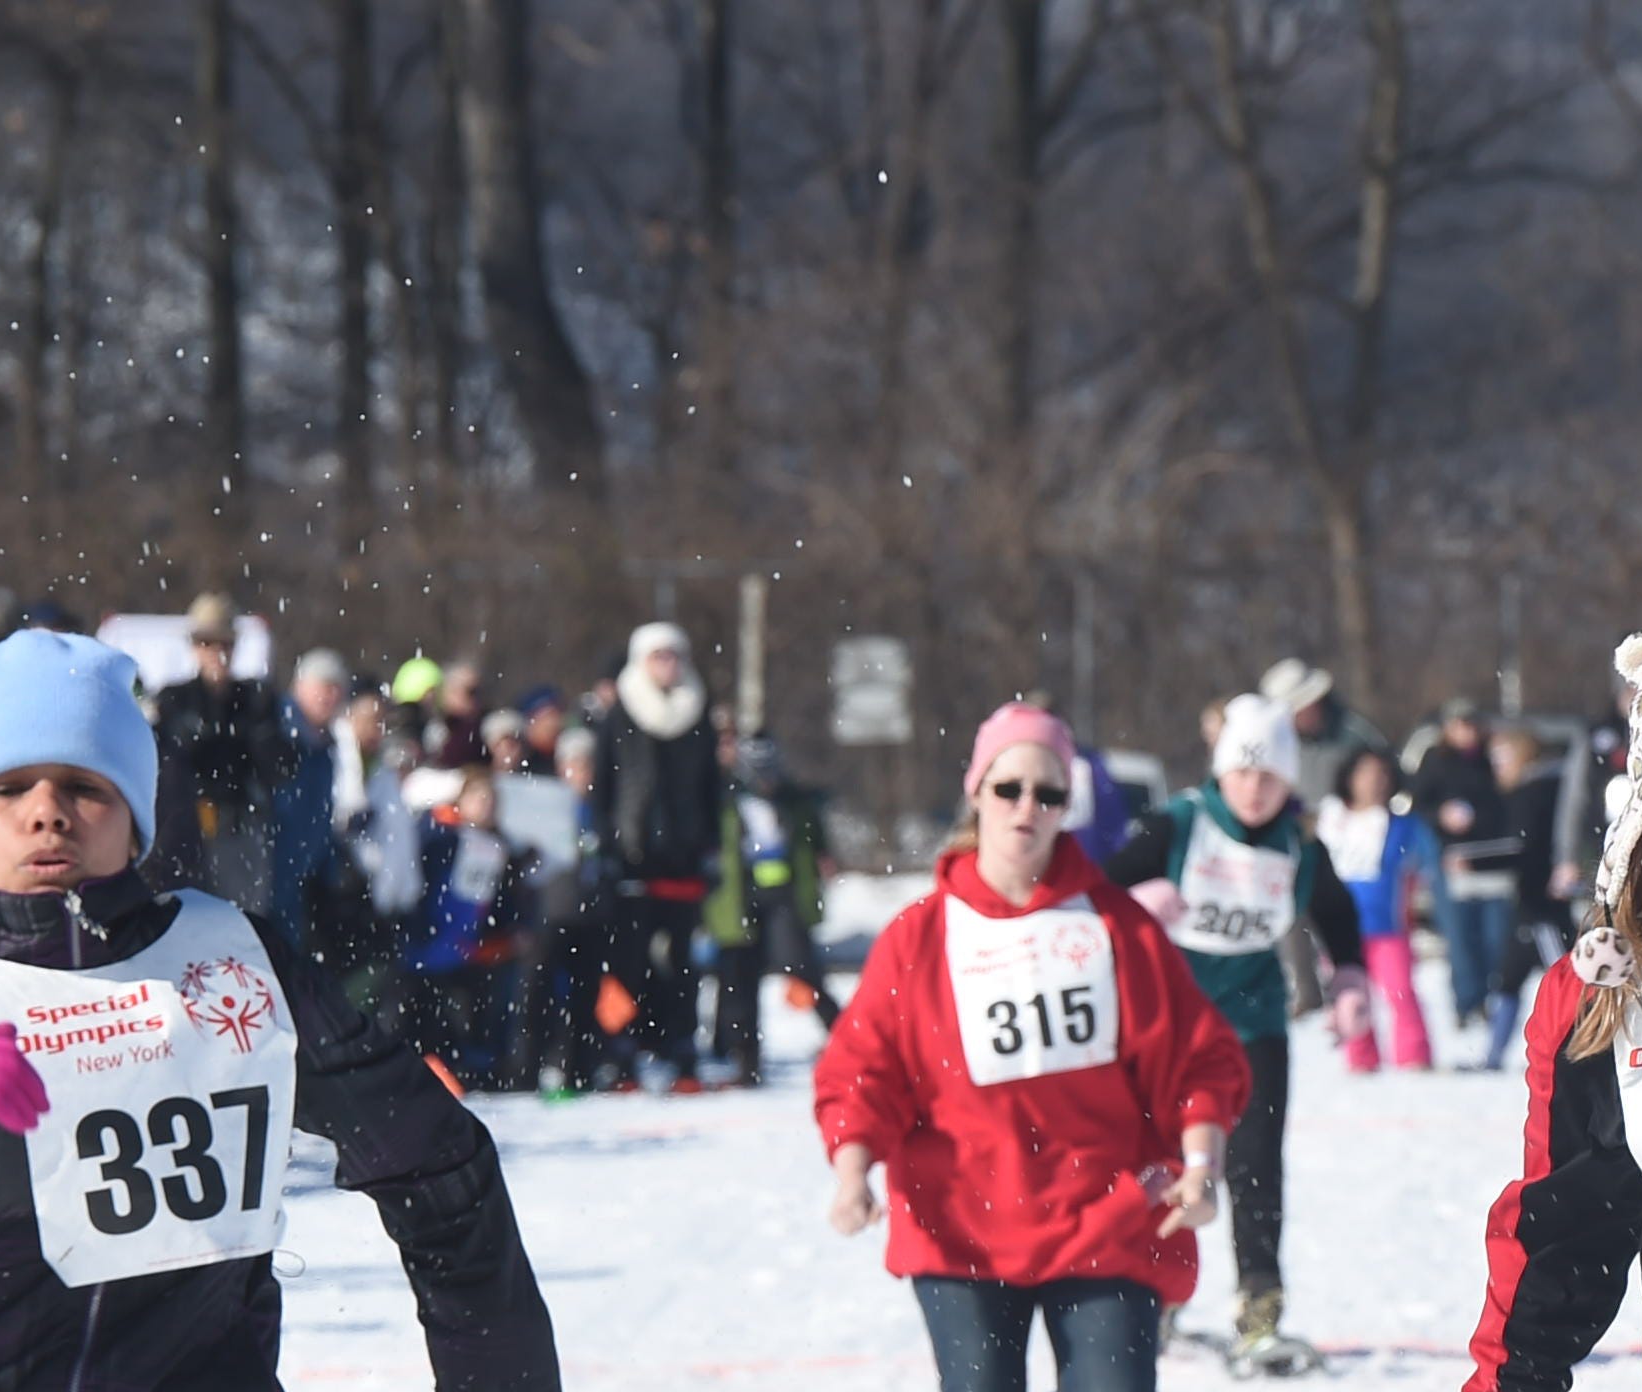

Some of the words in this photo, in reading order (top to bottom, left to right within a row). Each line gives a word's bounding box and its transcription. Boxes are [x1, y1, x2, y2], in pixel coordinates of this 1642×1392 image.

[26, 983, 150, 1025] Special
[987, 985, 1096, 1055] 315
[76, 1052, 124, 1074] New
[128, 1039, 175, 1063] York
[75, 1085, 269, 1235] 337
